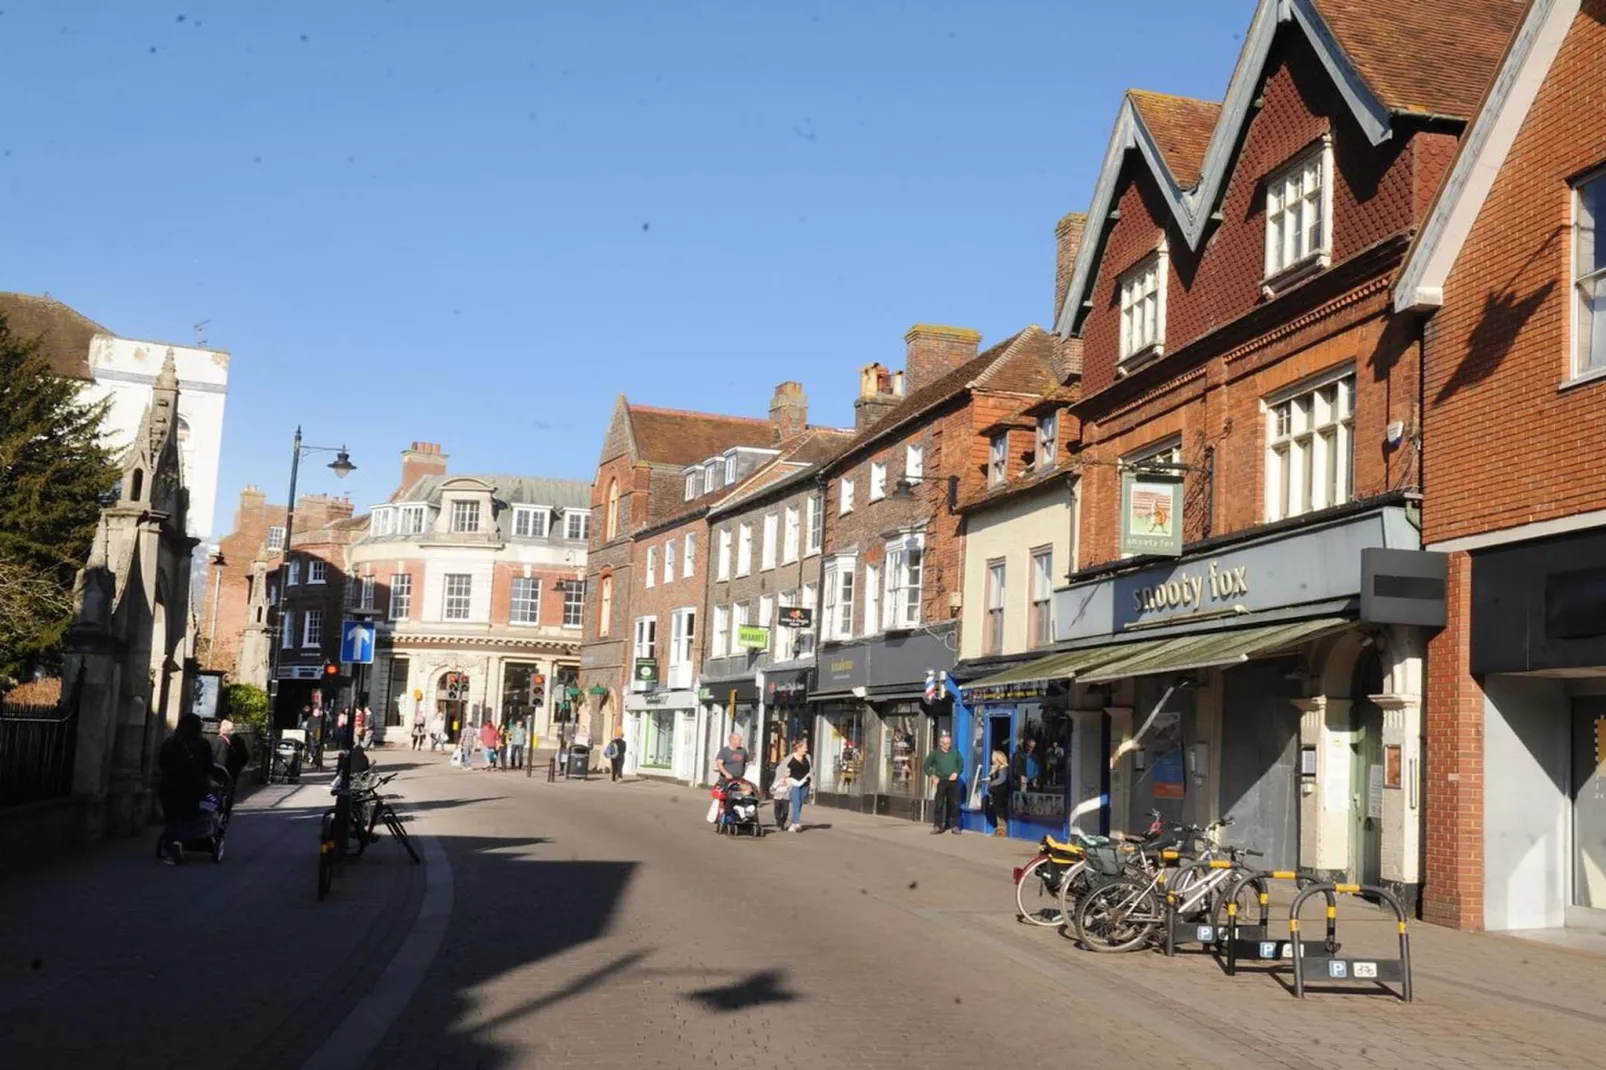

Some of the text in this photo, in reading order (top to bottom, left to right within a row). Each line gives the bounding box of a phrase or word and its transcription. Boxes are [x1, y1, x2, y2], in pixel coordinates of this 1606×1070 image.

[1127, 538, 1175, 548] snooty fox
[1132, 560, 1248, 611] snooty fox
[1264, 944, 1274, 956] P
[1333, 962, 1343, 975] P
